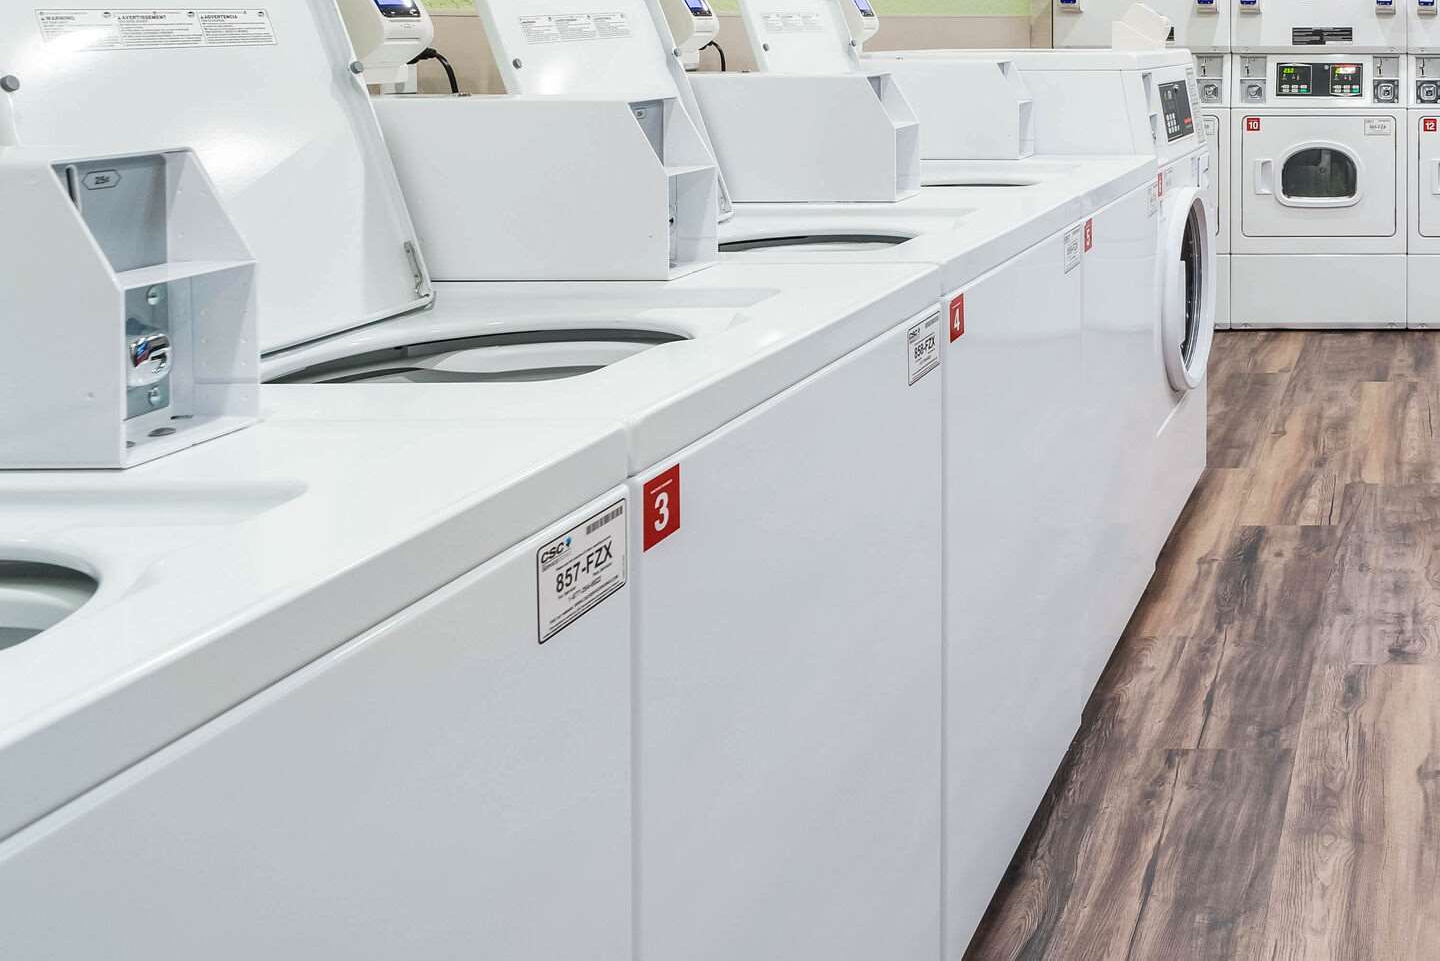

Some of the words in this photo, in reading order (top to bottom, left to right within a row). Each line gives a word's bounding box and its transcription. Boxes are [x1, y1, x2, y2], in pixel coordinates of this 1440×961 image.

[1248, 121, 1258, 129] 10
[1425, 122, 1435, 130] 12
[953, 308, 960, 331] 4
[654, 491, 669, 532] 3
[541, 542, 564, 564] CSC
[556, 540, 612, 593] 857-FZX
